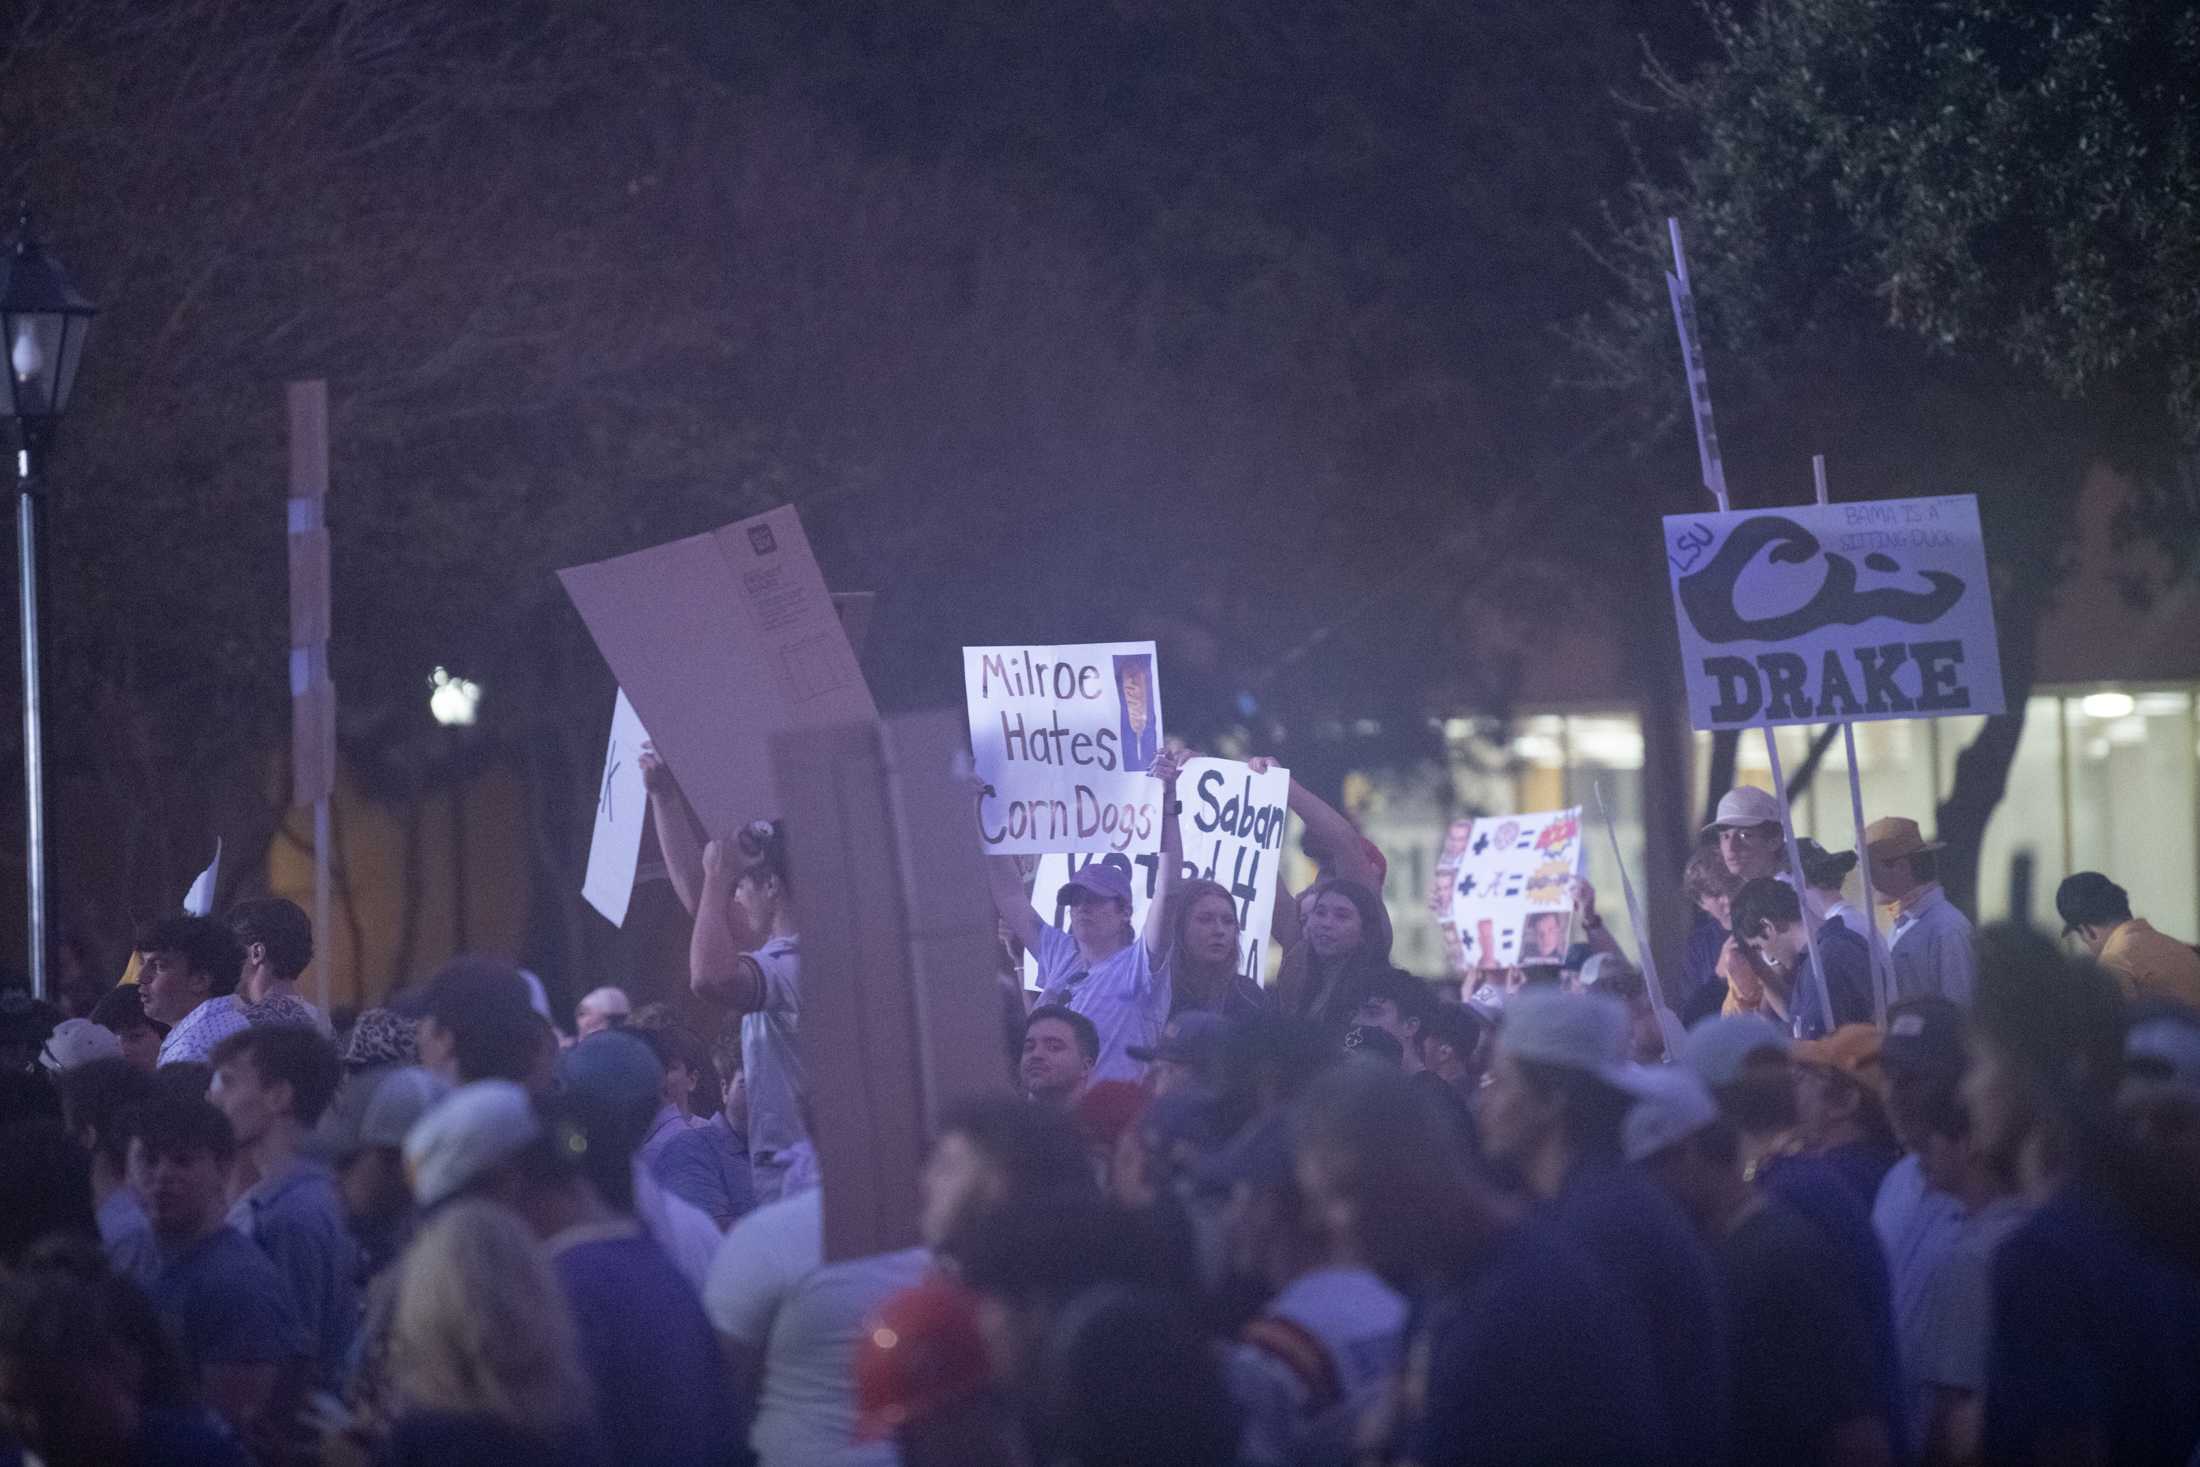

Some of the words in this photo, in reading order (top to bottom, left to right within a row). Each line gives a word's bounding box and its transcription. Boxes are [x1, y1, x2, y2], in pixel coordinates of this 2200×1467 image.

[1845, 504, 1896, 525] BAMA
[1902, 504, 1922, 523] IS
[1929, 504, 1940, 521] A
[1669, 522, 1714, 572] LSU
[980, 648, 1103, 701] Milroe
[1702, 640, 1970, 722] DRAKE
[1001, 709, 1118, 771] Hates
[976, 784, 1068, 844] Corn
[1074, 784, 1157, 851] Dogs
[1193, 769, 1285, 850] Saban
